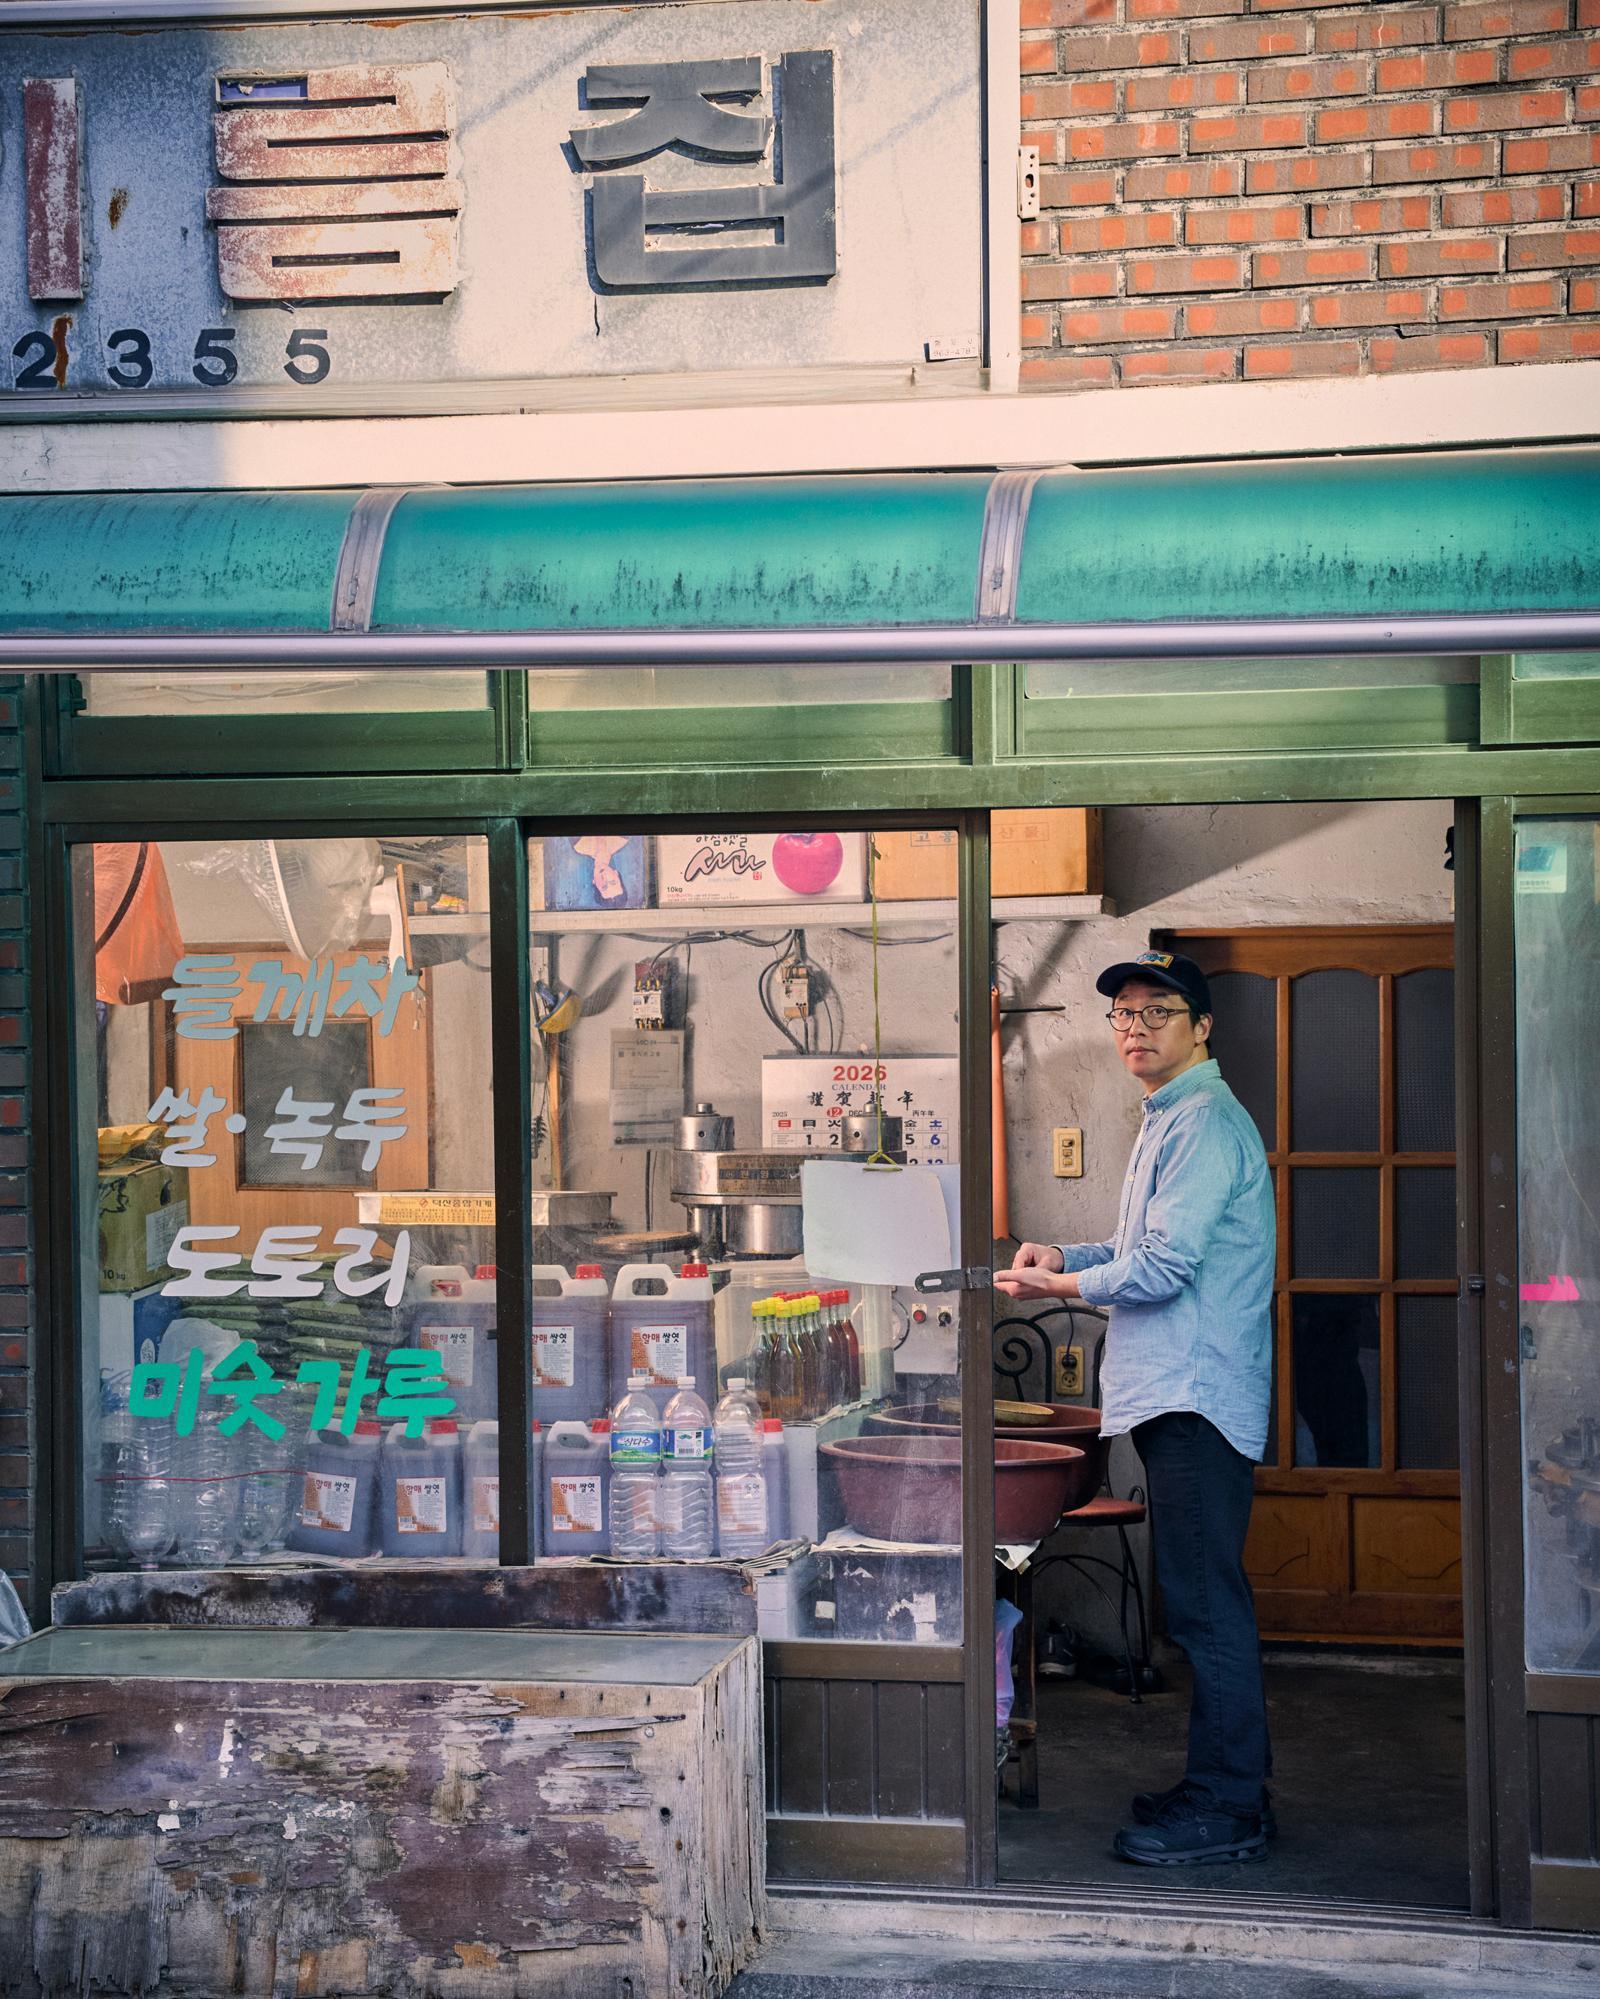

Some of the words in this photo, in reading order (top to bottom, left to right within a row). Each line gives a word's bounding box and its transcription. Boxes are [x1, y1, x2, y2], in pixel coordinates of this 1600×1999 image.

[162, 955, 421, 1040] 들깨차
[831, 1083, 887, 1091] CALENDR
[833, 1065, 887, 1081] 2026
[806, 1134, 812, 1146] 1
[830, 1134, 840, 1146] 2
[905, 1133, 915, 1145] 5
[930, 1133, 940, 1145] 6
[161, 1225, 411, 1308] 도토리
[129, 1340, 456, 1442] 미숫가루
